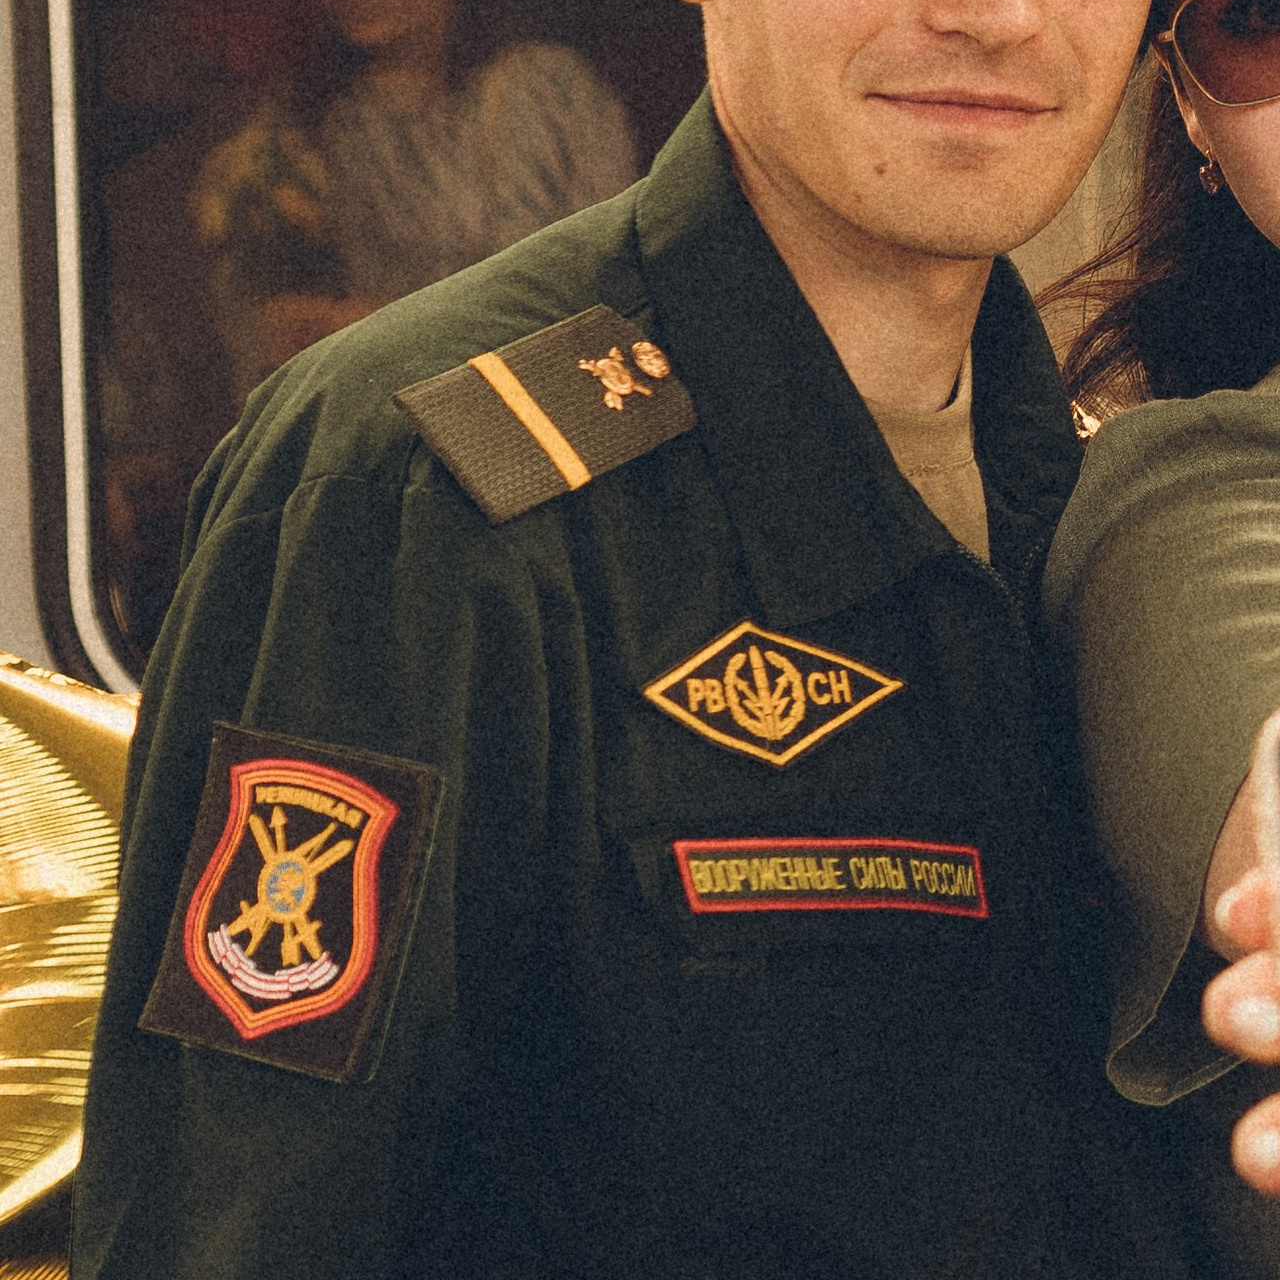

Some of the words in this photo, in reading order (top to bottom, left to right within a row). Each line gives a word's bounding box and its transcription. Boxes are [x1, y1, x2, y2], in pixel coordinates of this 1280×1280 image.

[686, 677, 727, 714] РВ
[806, 670, 853, 707] СН
[688, 856, 848, 894] ВООРУЖЕННЫЕ
[848, 856, 907, 891] СИЛЫ
[910, 859, 977, 897] РОССИИ
